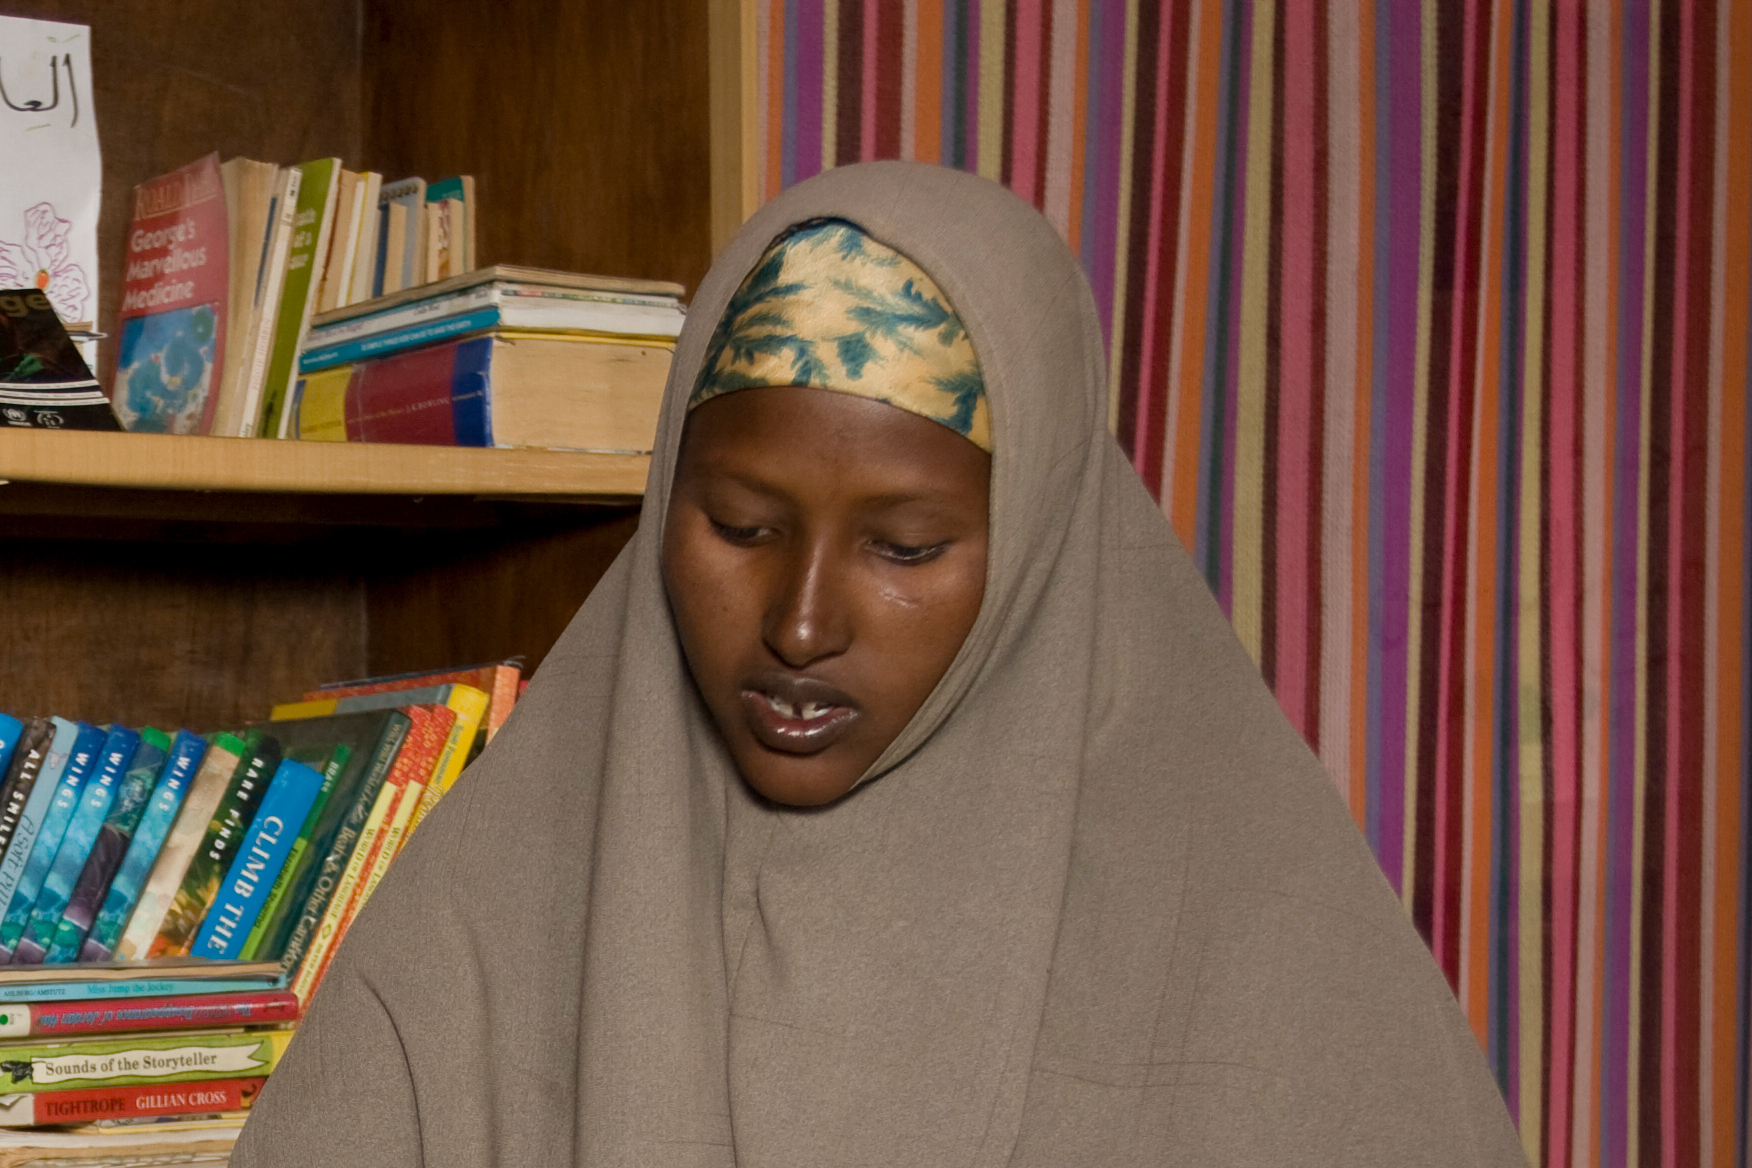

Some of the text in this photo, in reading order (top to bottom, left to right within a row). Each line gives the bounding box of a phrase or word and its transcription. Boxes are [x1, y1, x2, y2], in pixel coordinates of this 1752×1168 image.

[130, 219, 196, 252] George's
[126, 247, 206, 282] Marvellous
[122, 280, 194, 311] Medicine
[20, 749, 41, 780] ALL
[57, 752, 89, 808] WINGS
[91, 752, 123, 807] WINGS
[159, 756, 191, 811] WINGS
[209, 757, 265, 860] RARE FINDS
[5, 833, 31, 872] Soft
[233, 816, 284, 898] CLIMB
[305, 874, 334, 915] Other
[207, 903, 244, 954] THE
[87, 984, 105, 995] Miss
[107, 983, 131, 996] Jump
[132, 983, 145, 993] the
[145, 982, 175, 994] Jockey
[45, 1053, 218, 1076] Sounds of the Storyteller
[44, 1090, 227, 1116] TIGHTROPE GILLIAN CROSS
